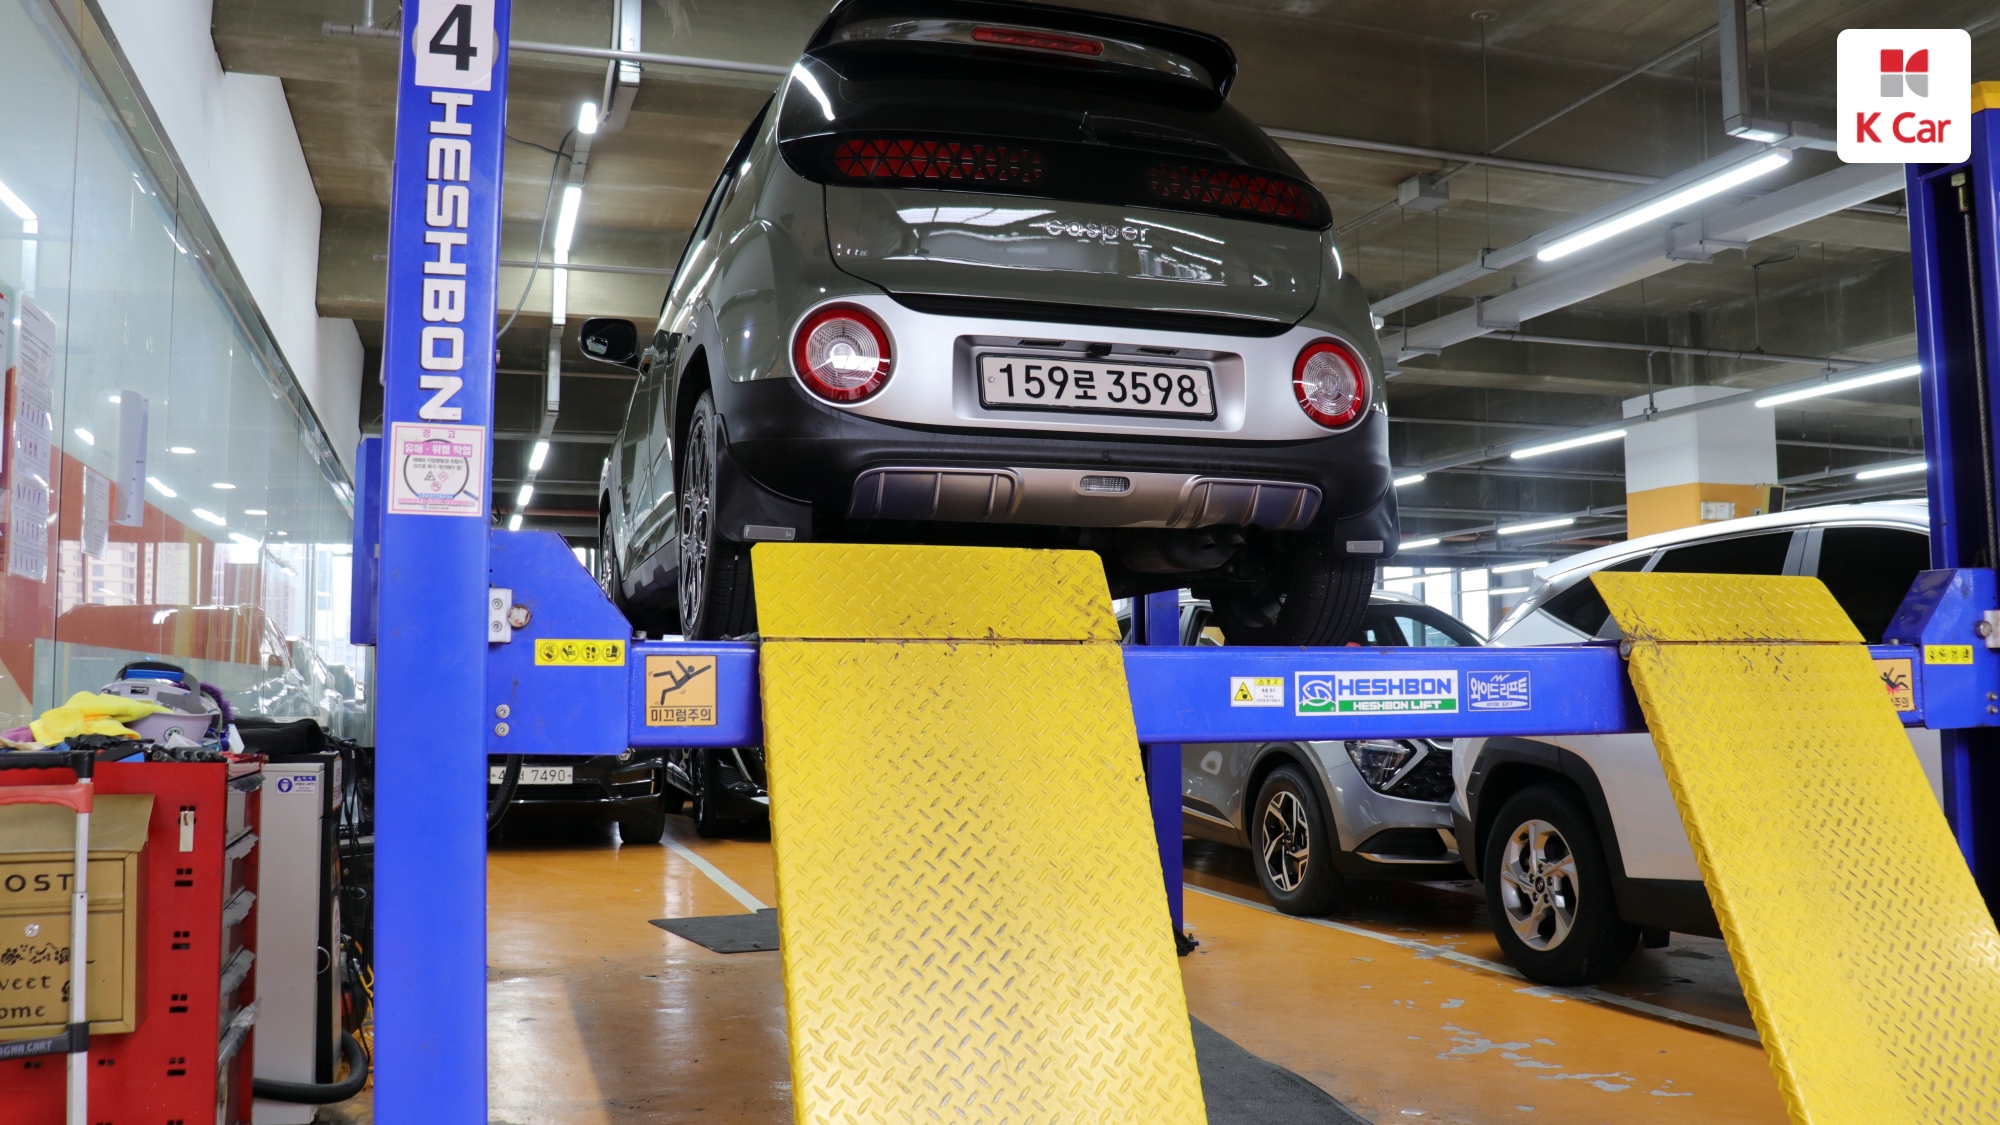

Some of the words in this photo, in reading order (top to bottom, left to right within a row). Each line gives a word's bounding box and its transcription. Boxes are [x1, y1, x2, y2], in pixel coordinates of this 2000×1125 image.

[429, 4, 477, 71] 4
[1045, 219, 1149, 243] casper
[418, 91, 473, 421] HESHBON
[999, 363, 1097, 400] 159로
[1106, 370, 1198, 407] 3598
[1338, 678, 1451, 695] HESHBON
[1470, 677, 1528, 701] 와이드리프트
[1353, 700, 1409, 710] HESHBON
[1411, 700, 1442, 710] LIFT
[1890, 697, 1909, 708] 주의
[651, 708, 711, 722] 미끄럼주의
[531, 769, 566, 782] 7490
